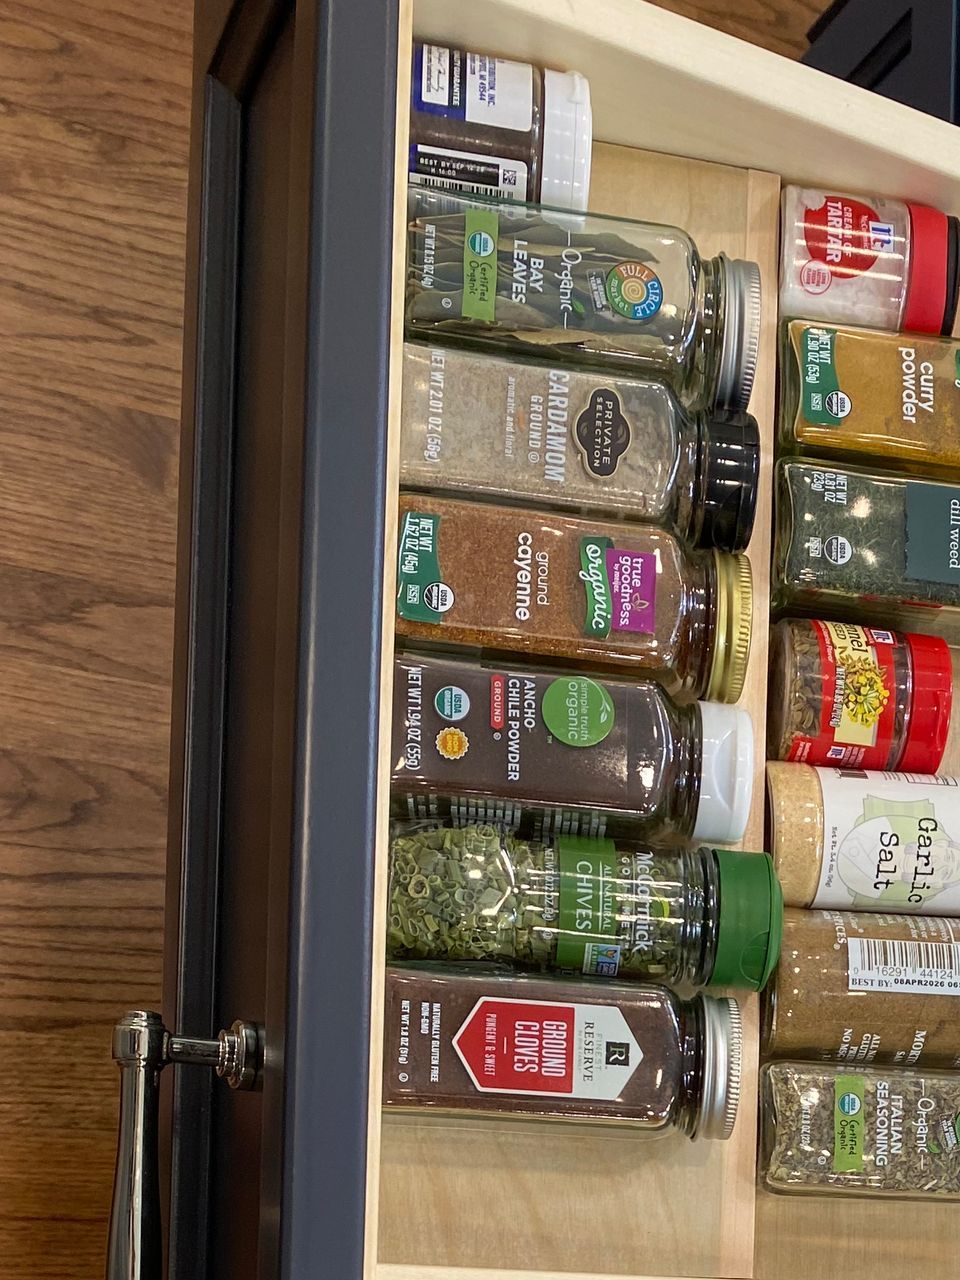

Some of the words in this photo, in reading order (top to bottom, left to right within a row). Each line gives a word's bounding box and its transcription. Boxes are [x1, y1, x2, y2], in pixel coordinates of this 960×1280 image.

[826, 202, 842, 262] TARTAR
[468, 260, 478, 295] Organic
[479, 262, 492, 302] Certified
[511, 240, 527, 303] LEAVES
[530, 258, 544, 292] BAY
[554, 249, 582, 311] Organic
[611, 279, 629, 311] market
[635, 281, 659, 318] CIRCLE
[807, 352, 819, 362] OZ
[819, 350, 830, 364] WT
[820, 334, 831, 349] NET
[898, 347, 918, 423] powder
[918, 362, 935, 412] curry
[529, 395, 543, 448] GROUND
[544, 370, 569, 482] CARDAMOM
[593, 396, 603, 467] SELECTION
[602, 401, 613, 465] PRIVATE
[836, 492, 846, 505] WT
[837, 474, 846, 490] NET
[406, 537, 418, 549] OZ
[419, 534, 431, 551] WT
[420, 518, 433, 533] NET
[949, 528, 960, 568] weed
[514, 532, 532, 620] cayenne
[535, 551, 549, 605] ground
[579, 544, 611, 629] organic
[631, 558, 643, 587] true
[408, 668, 422, 686] NET
[408, 688, 421, 703] WT
[453, 694, 461, 713] USDA
[508, 679, 520, 719] CHILE
[566, 682, 580, 739] organic
[578, 681, 589, 714] simple
[407, 728, 420, 740] OZ
[580, 716, 589, 740] truth
[508, 721, 519, 780] POWDER
[874, 832, 899, 890] Salt
[908, 817, 937, 903] Garlic
[575, 861, 593, 930] CHIVES
[851, 978, 871, 986] BEST
[485, 1014, 496, 1043] PUNGENT
[514, 1021, 539, 1071] CLOVES
[541, 1021, 567, 1076] GROUND
[843, 1028, 852, 1041] NO
[485, 1054, 495, 1075] SWEET
[584, 1021, 593, 1081] RESERVE
[849, 1120, 858, 1155] Certified
[876, 1080, 888, 1166] SEASONING
[890, 1095, 902, 1153] ITALIAN
[910, 1098, 935, 1153] Organic
